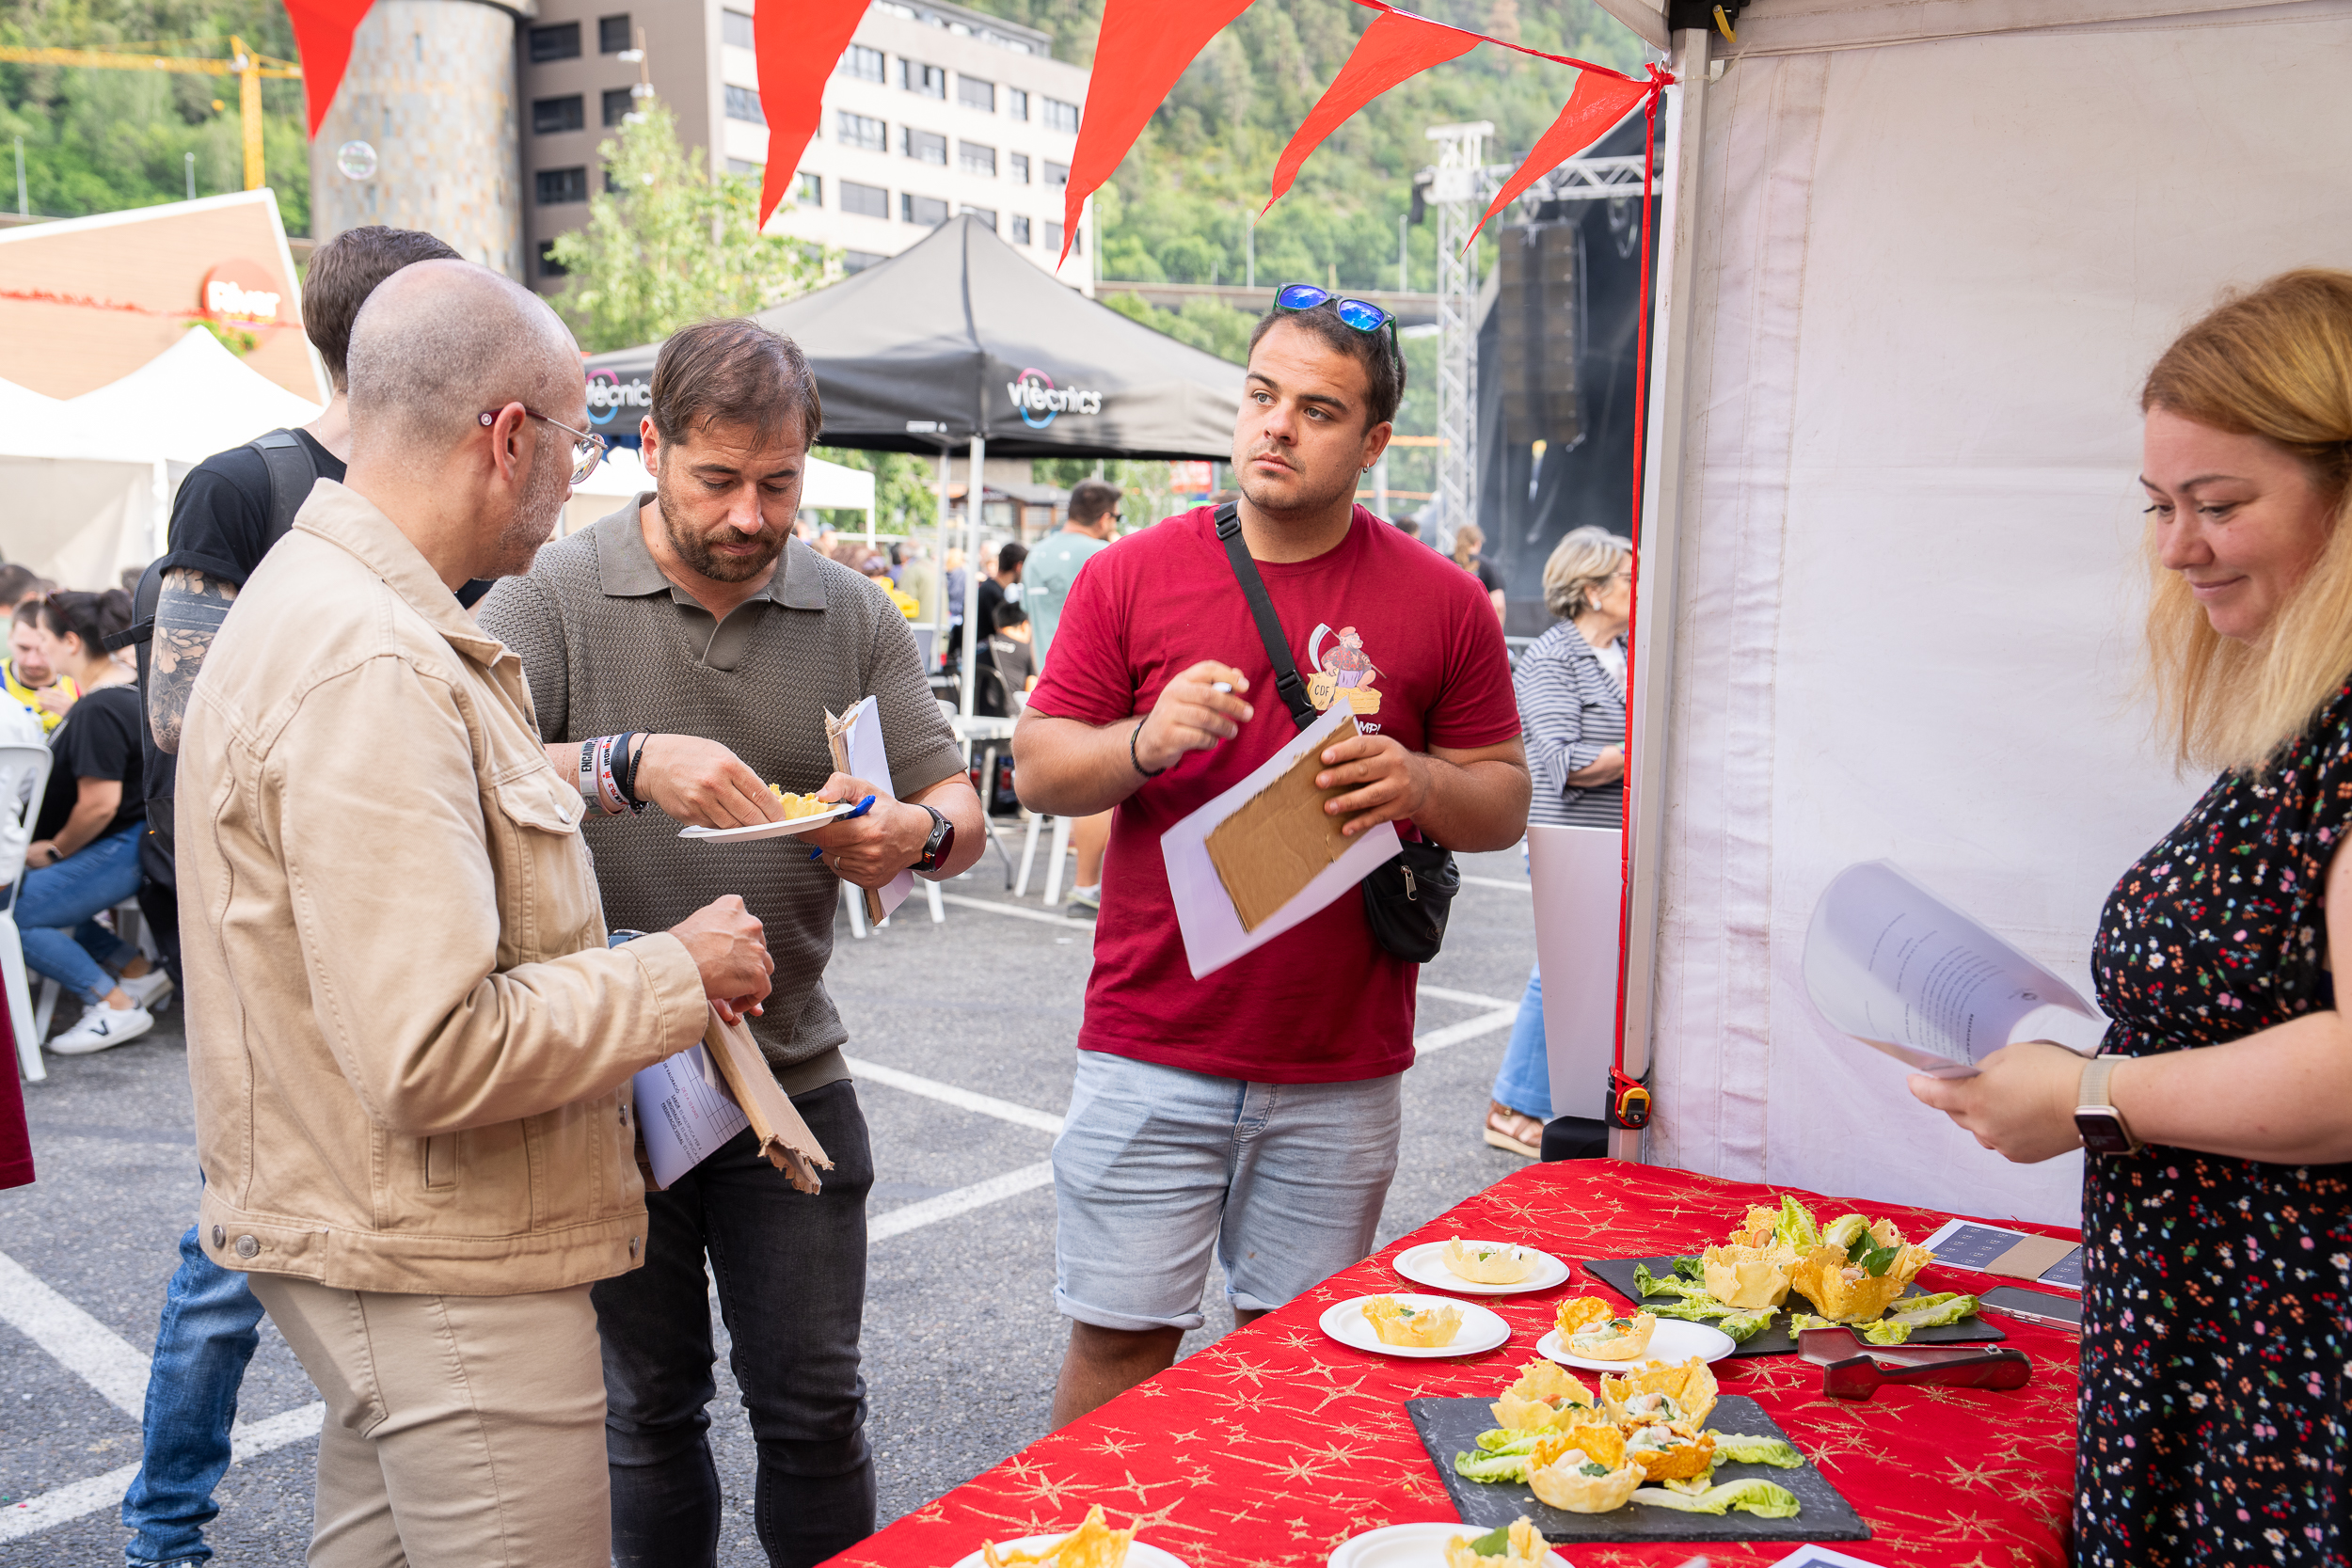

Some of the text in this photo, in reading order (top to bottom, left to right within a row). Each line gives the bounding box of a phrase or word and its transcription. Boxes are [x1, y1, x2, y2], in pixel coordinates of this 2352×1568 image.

[585, 377, 653, 407] tècnic
[1314, 684, 1330, 697] CDF
[682, 1115, 695, 1139] MULTIPLICA
